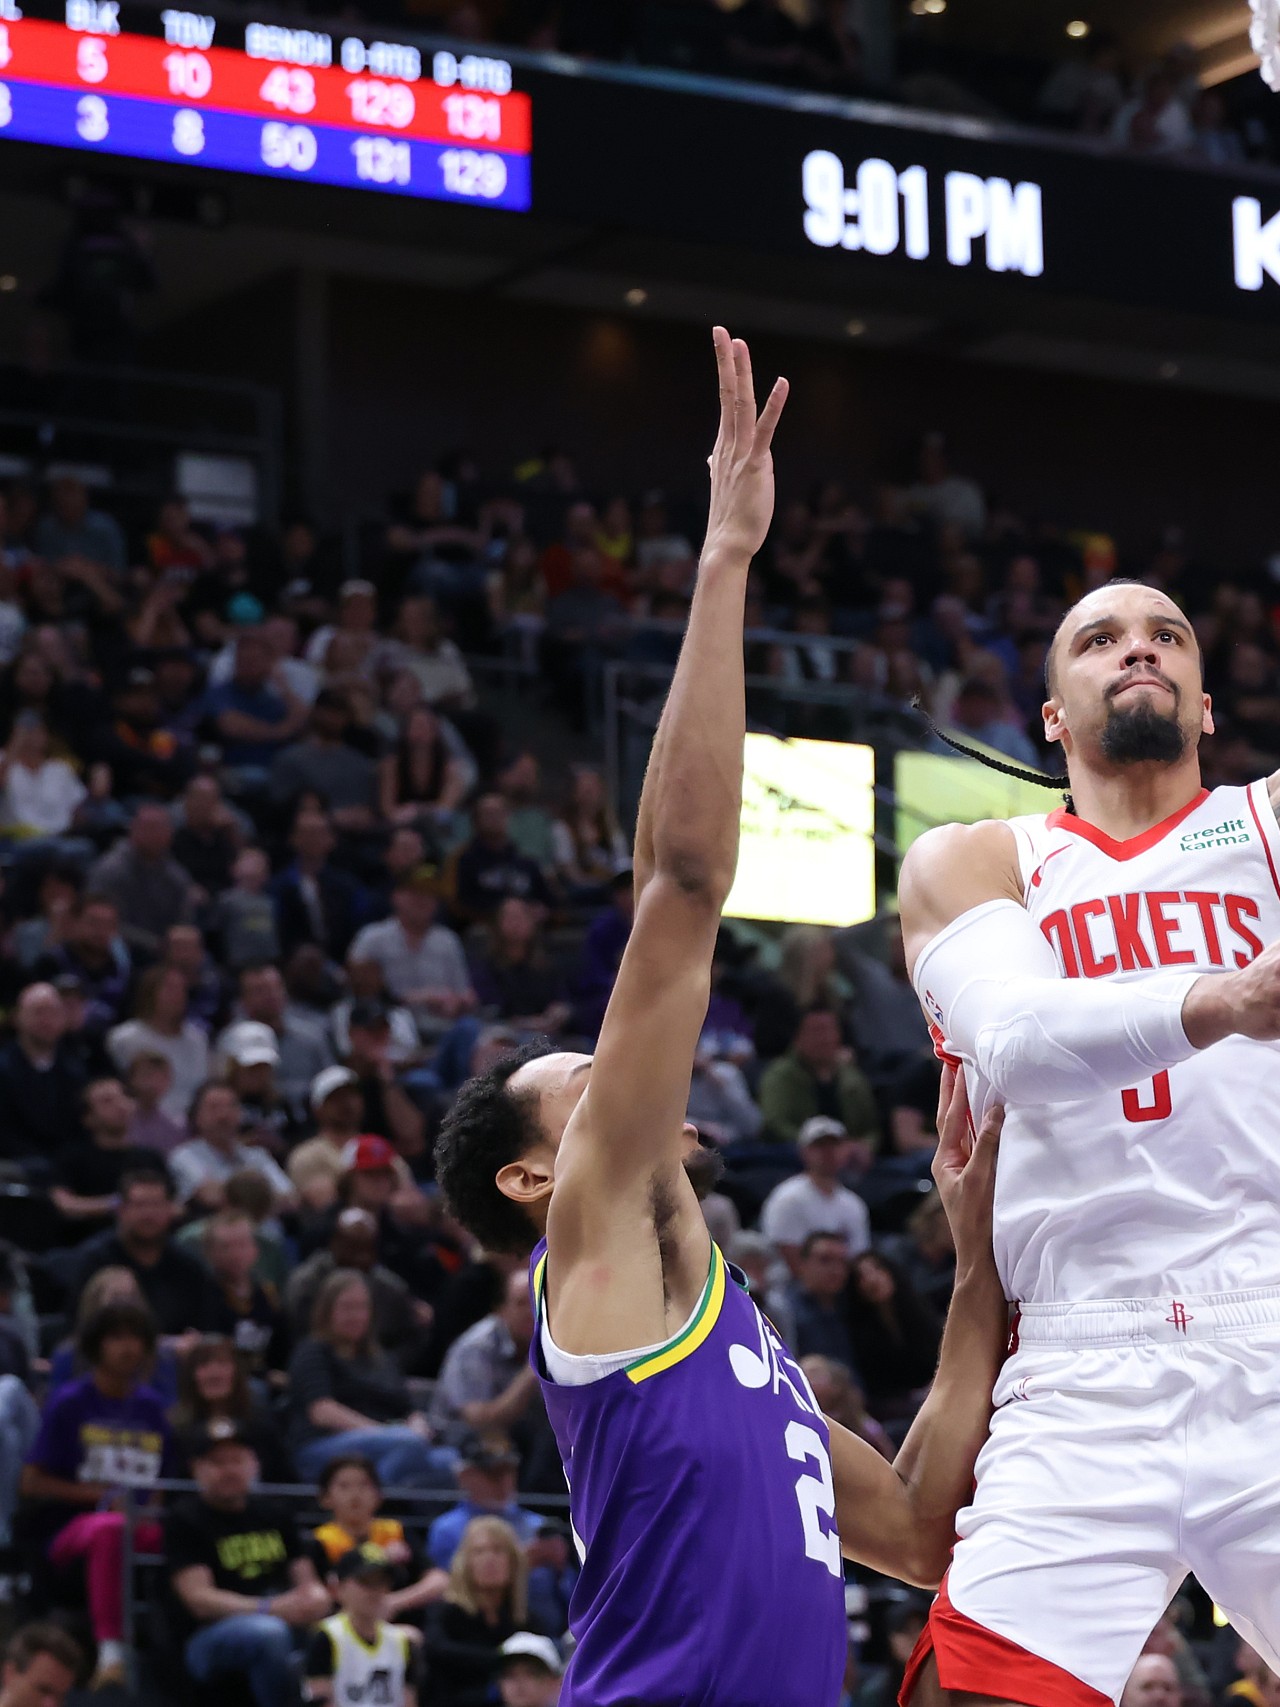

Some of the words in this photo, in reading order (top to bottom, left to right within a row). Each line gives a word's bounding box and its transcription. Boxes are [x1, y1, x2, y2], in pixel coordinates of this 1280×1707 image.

[77, 36, 108, 83] 5
[162, 51, 212, 99] 10
[259, 66, 316, 114] 43
[345, 79, 415, 128] 129
[441, 93, 501, 141] 131
[76, 94, 109, 142] 3
[260, 121, 317, 171] 50
[351, 136, 411, 186] 131
[438, 148, 507, 198] 129
[802, 150, 929, 260] 9:01
[945, 171, 1044, 277] PM
[1180, 833, 1250, 851] karma
[1181, 819, 1246, 842] credit
